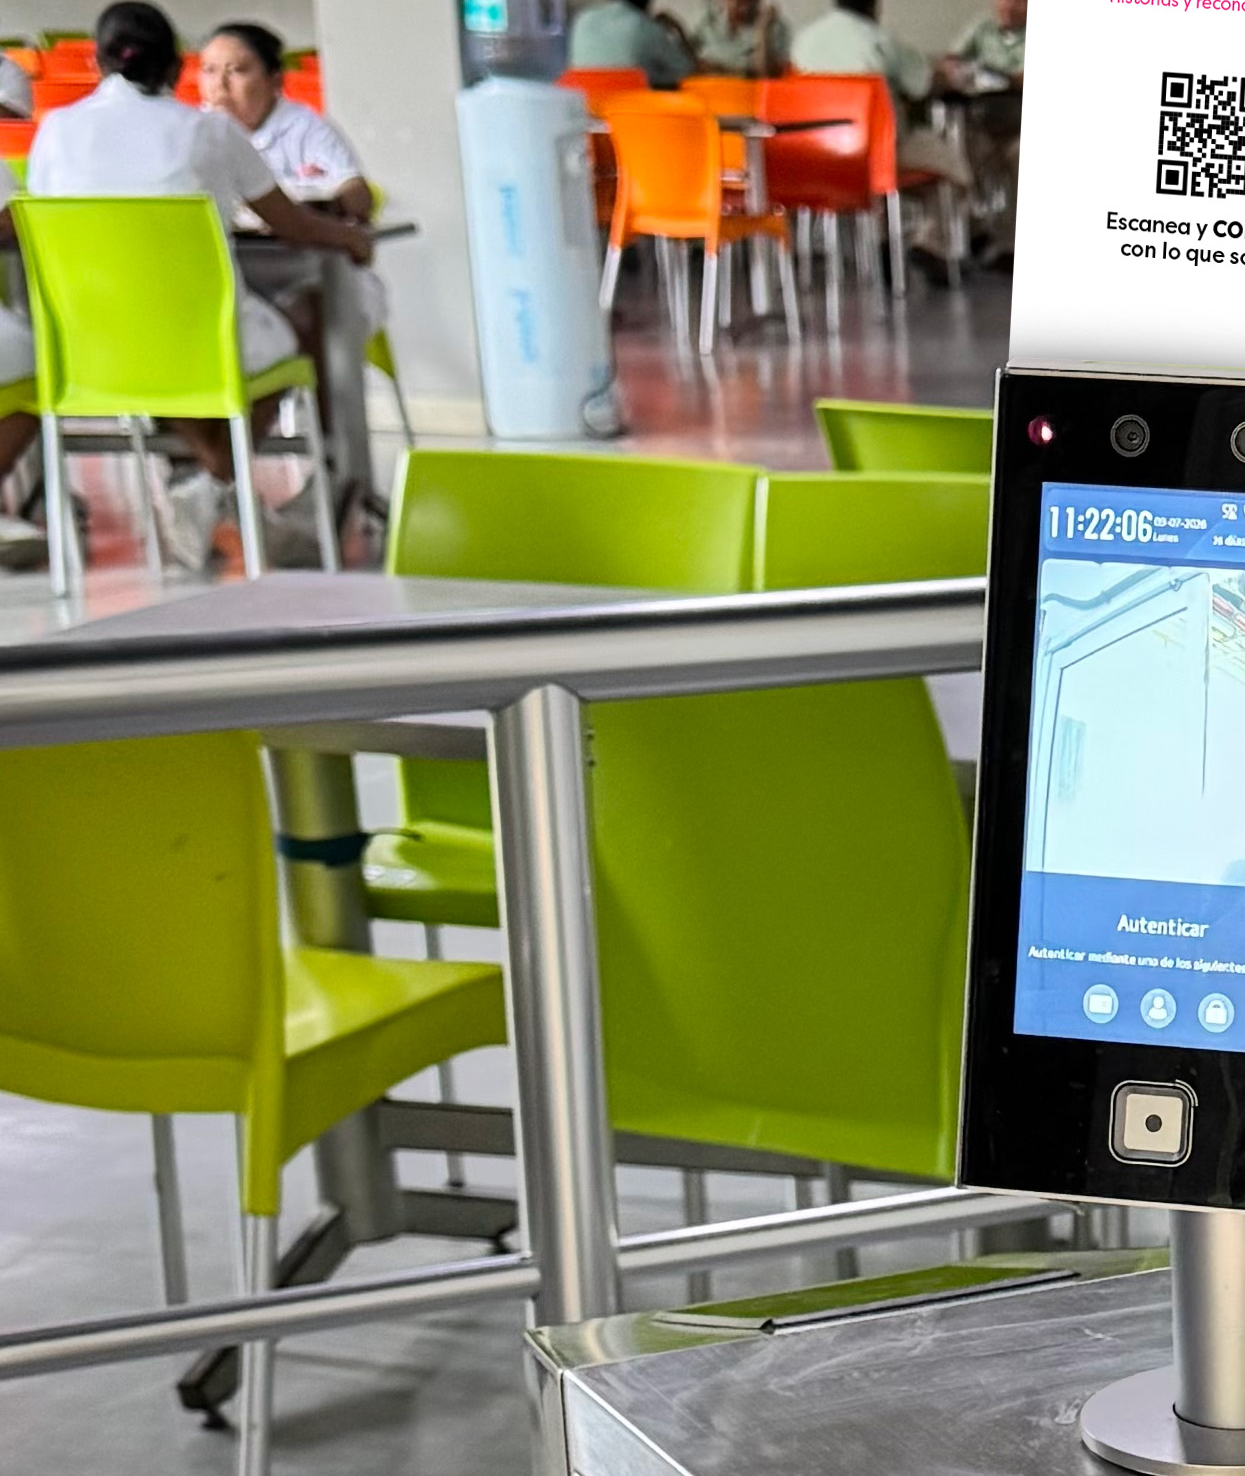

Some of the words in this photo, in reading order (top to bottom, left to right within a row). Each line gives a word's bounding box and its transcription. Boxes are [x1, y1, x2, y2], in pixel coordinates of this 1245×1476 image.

[1106, 211, 1191, 236] Escanea
[1196, 222, 1209, 242] y
[1120, 243, 1157, 259] con
[1162, 241, 1181, 260] lo
[1185, 248, 1225, 267] que
[1050, 506, 1151, 543] 11:22:06
[1117, 914, 1209, 938] Autenticar
[1028, 945, 1085, 962] Autenticar
[1088, 952, 1136, 967] mediante
[1160, 956, 1174, 969] de
[1176, 957, 1192, 971] los
